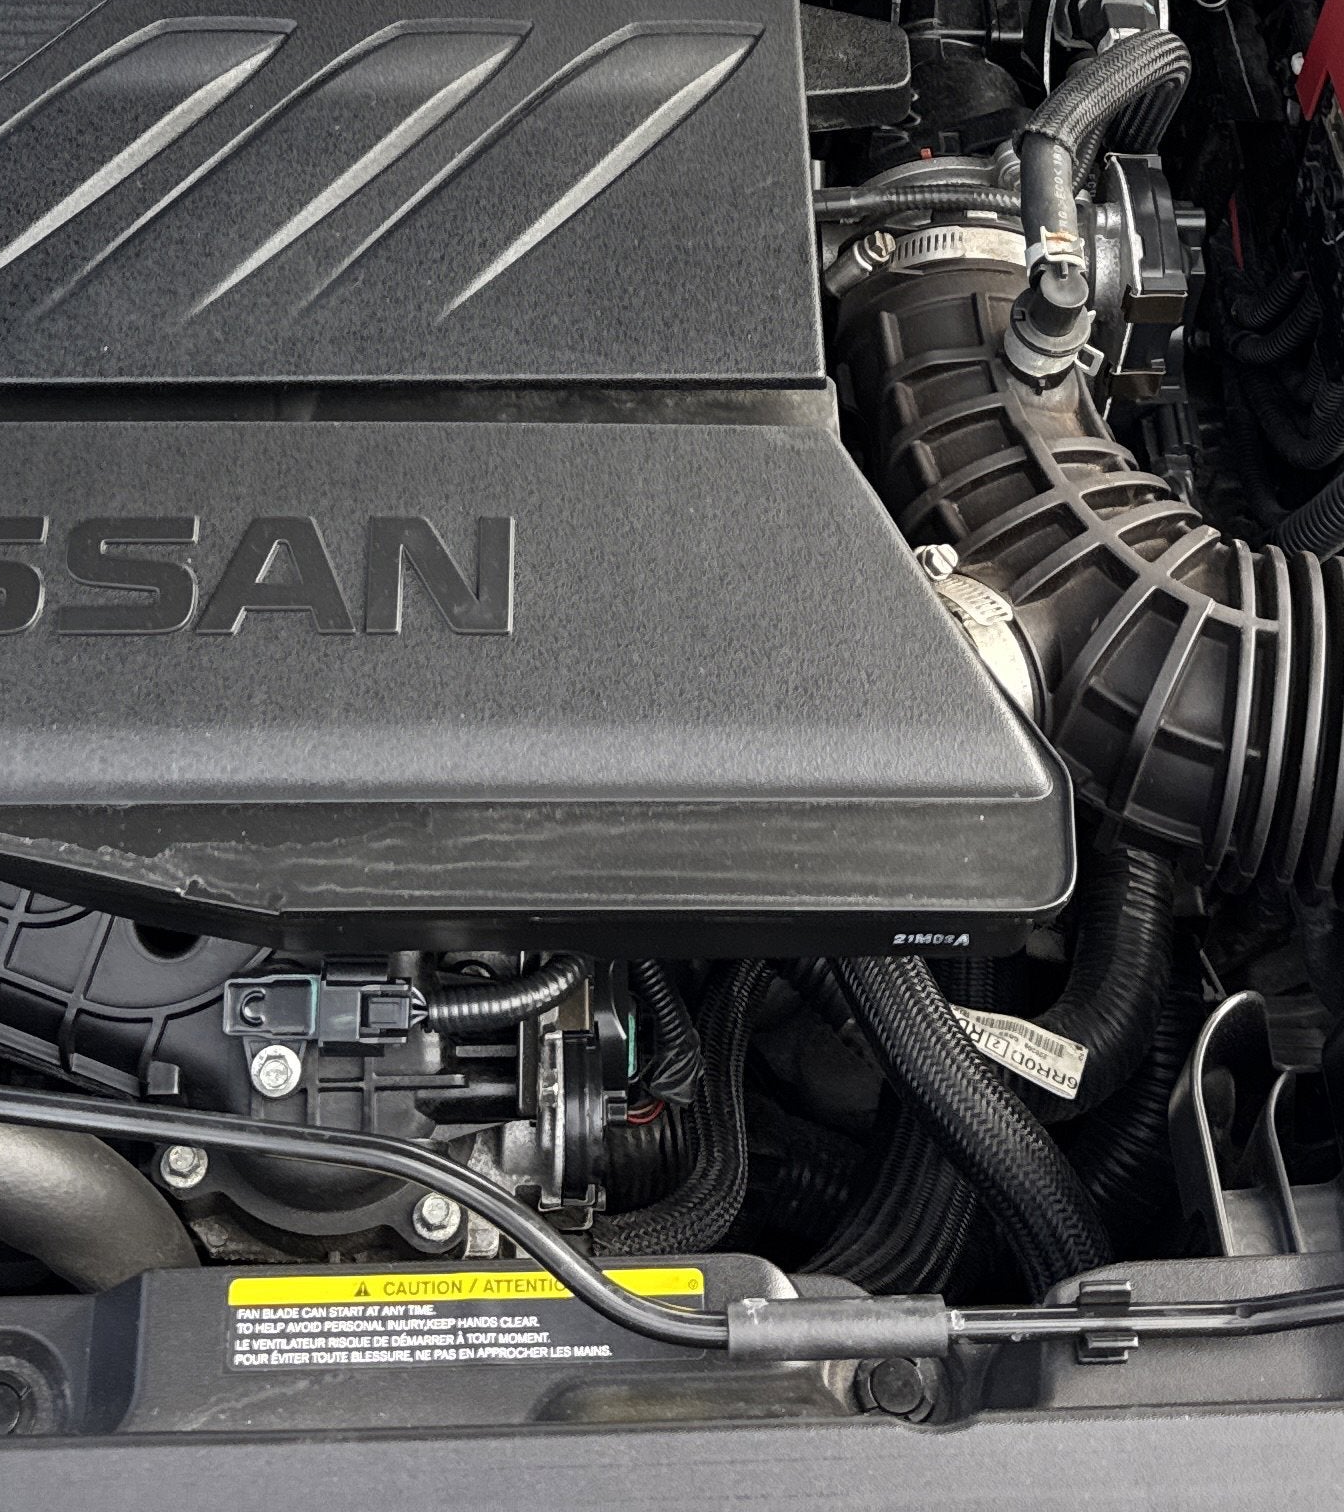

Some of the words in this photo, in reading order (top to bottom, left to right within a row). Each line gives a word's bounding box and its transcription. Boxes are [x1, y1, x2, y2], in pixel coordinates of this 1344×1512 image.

[992, 1041, 1001, 1049] 2
[383, 1280, 463, 1296] CAUTION
[467, 1278, 478, 1293] /
[483, 1277, 567, 1293] ATTENTIO
[236, 1307, 260, 1319] FAN
[262, 1307, 300, 1319] BLADE
[301, 1306, 327, 1318] CAN
[328, 1305, 365, 1317] START
[365, 1305, 381, 1316] AT
[381, 1305, 406, 1316] ANY
[407, 1304, 436, 1315] TIME.
[236, 1322, 253, 1334] TO
[254, 1321, 284, 1333] HELP
[286, 1320, 322, 1333] AVOID
[323, 1319, 384, 1332] PERSONAL
[458, 1316, 497, 1328] HANDS
[499, 1315, 540, 1327] CLEAR.
[234, 1338, 250, 1350] LE
[251, 1336, 326, 1350] VENTILATEUR
[327, 1335, 371, 1349] RISQUE
[373, 1334, 389, 1346] DE
[390, 1330, 455, 1346] DÉMARRER
[466, 1332, 497, 1344] TOUT
[498, 1331, 550, 1343] MOMENT.
[234, 1353, 269, 1365] POUR
[270, 1349, 310, 1364] ÉVITER
[311, 1351, 349, 1363] TOUTE
[350, 1349, 412, 1363] BLESSURE,
[414, 1349, 431, 1360] NE
[433, 1348, 457, 1360] PAS
[458, 1348, 476, 1359] EN
[476, 1346, 548, 1359] APPROCHER
[549, 1345, 572, 1357] LES
[573, 1344, 612, 1356] MAINS.
